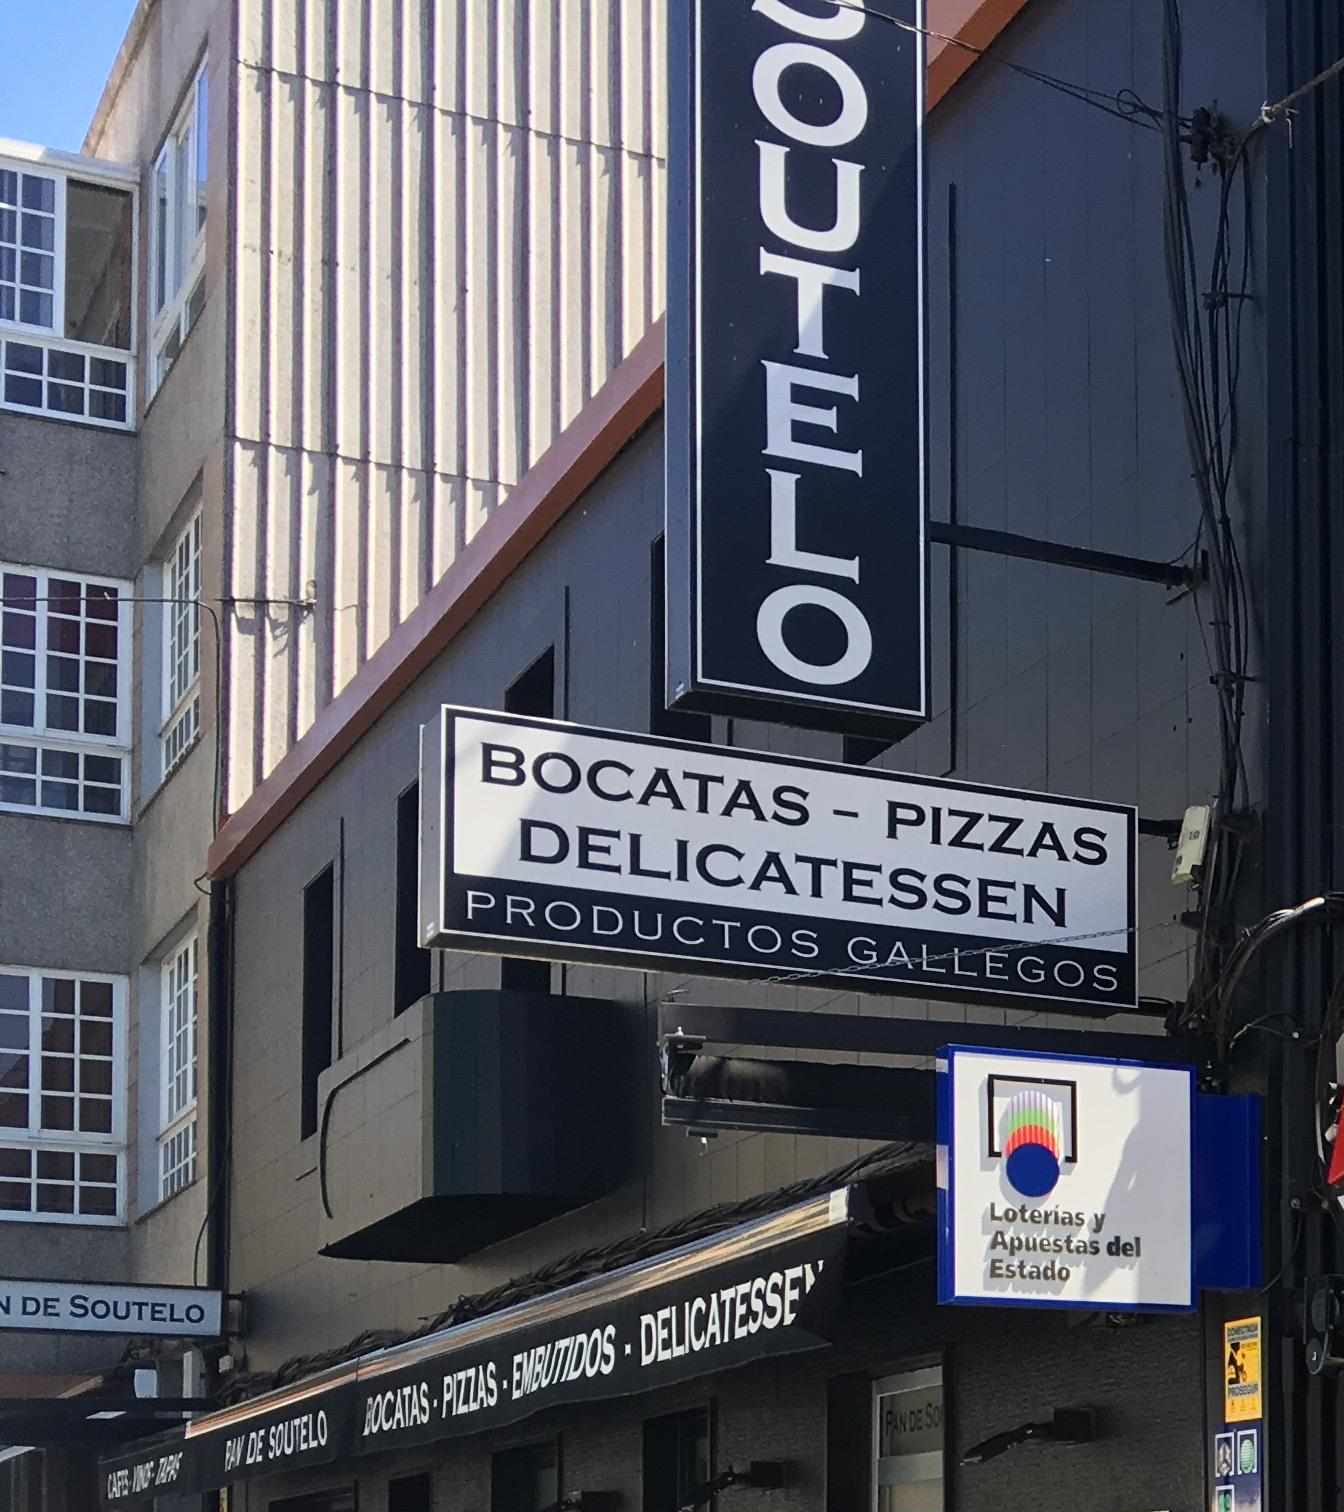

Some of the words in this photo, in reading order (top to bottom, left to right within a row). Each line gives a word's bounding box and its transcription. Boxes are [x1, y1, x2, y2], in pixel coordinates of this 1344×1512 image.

[480, 742, 811, 827] BOCATAS
[886, 799, 1109, 867] PIZZAS
[519, 817, 1067, 928] DELICATESSEN
[465, 890, 820, 957] PRODUCTOS
[847, 937, 1118, 992] GALLEGOS
[990, 1202, 1085, 1227] Loterías
[1092, 1212, 1106, 1233] y
[990, 1230, 1100, 1256] Apuestas
[1106, 1235, 1141, 1257] del
[990, 1258, 1071, 1281] Estado
[22, 1296, 60, 1317] DE
[69, 1293, 206, 1324] SOUTELO
[362, 1385, 430, 1436] BOCATAS
[442, 1361, 498, 1419] PIZZAS
[512, 1324, 616, 1400] EMBUTIDOS
[224, 1434, 246, 1473] PAN
[246, 1428, 266, 1465] DE
[268, 1410, 328, 1460] SOUTELO
